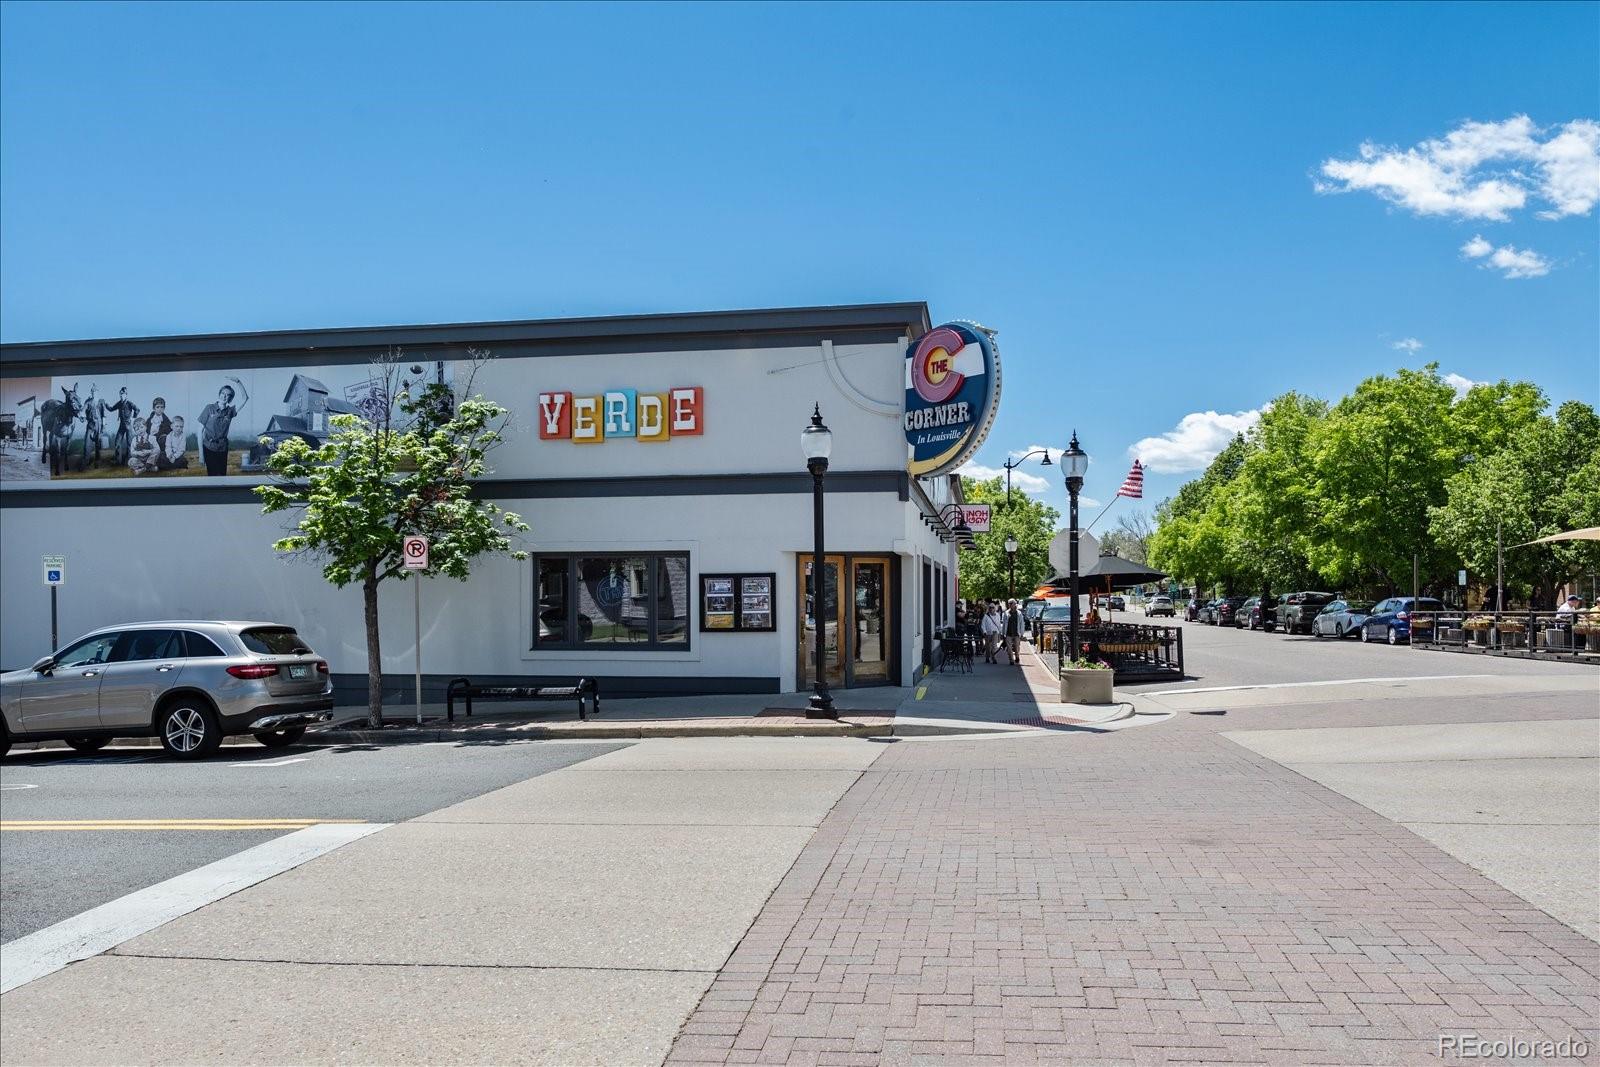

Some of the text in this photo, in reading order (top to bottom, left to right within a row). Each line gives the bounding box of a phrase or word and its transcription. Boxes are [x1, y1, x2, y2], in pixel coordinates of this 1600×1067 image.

[931, 359, 948, 375] THE
[539, 389, 697, 438] VERDE
[904, 401, 971, 432] CORNER
[917, 429, 961, 445] In Louisville
